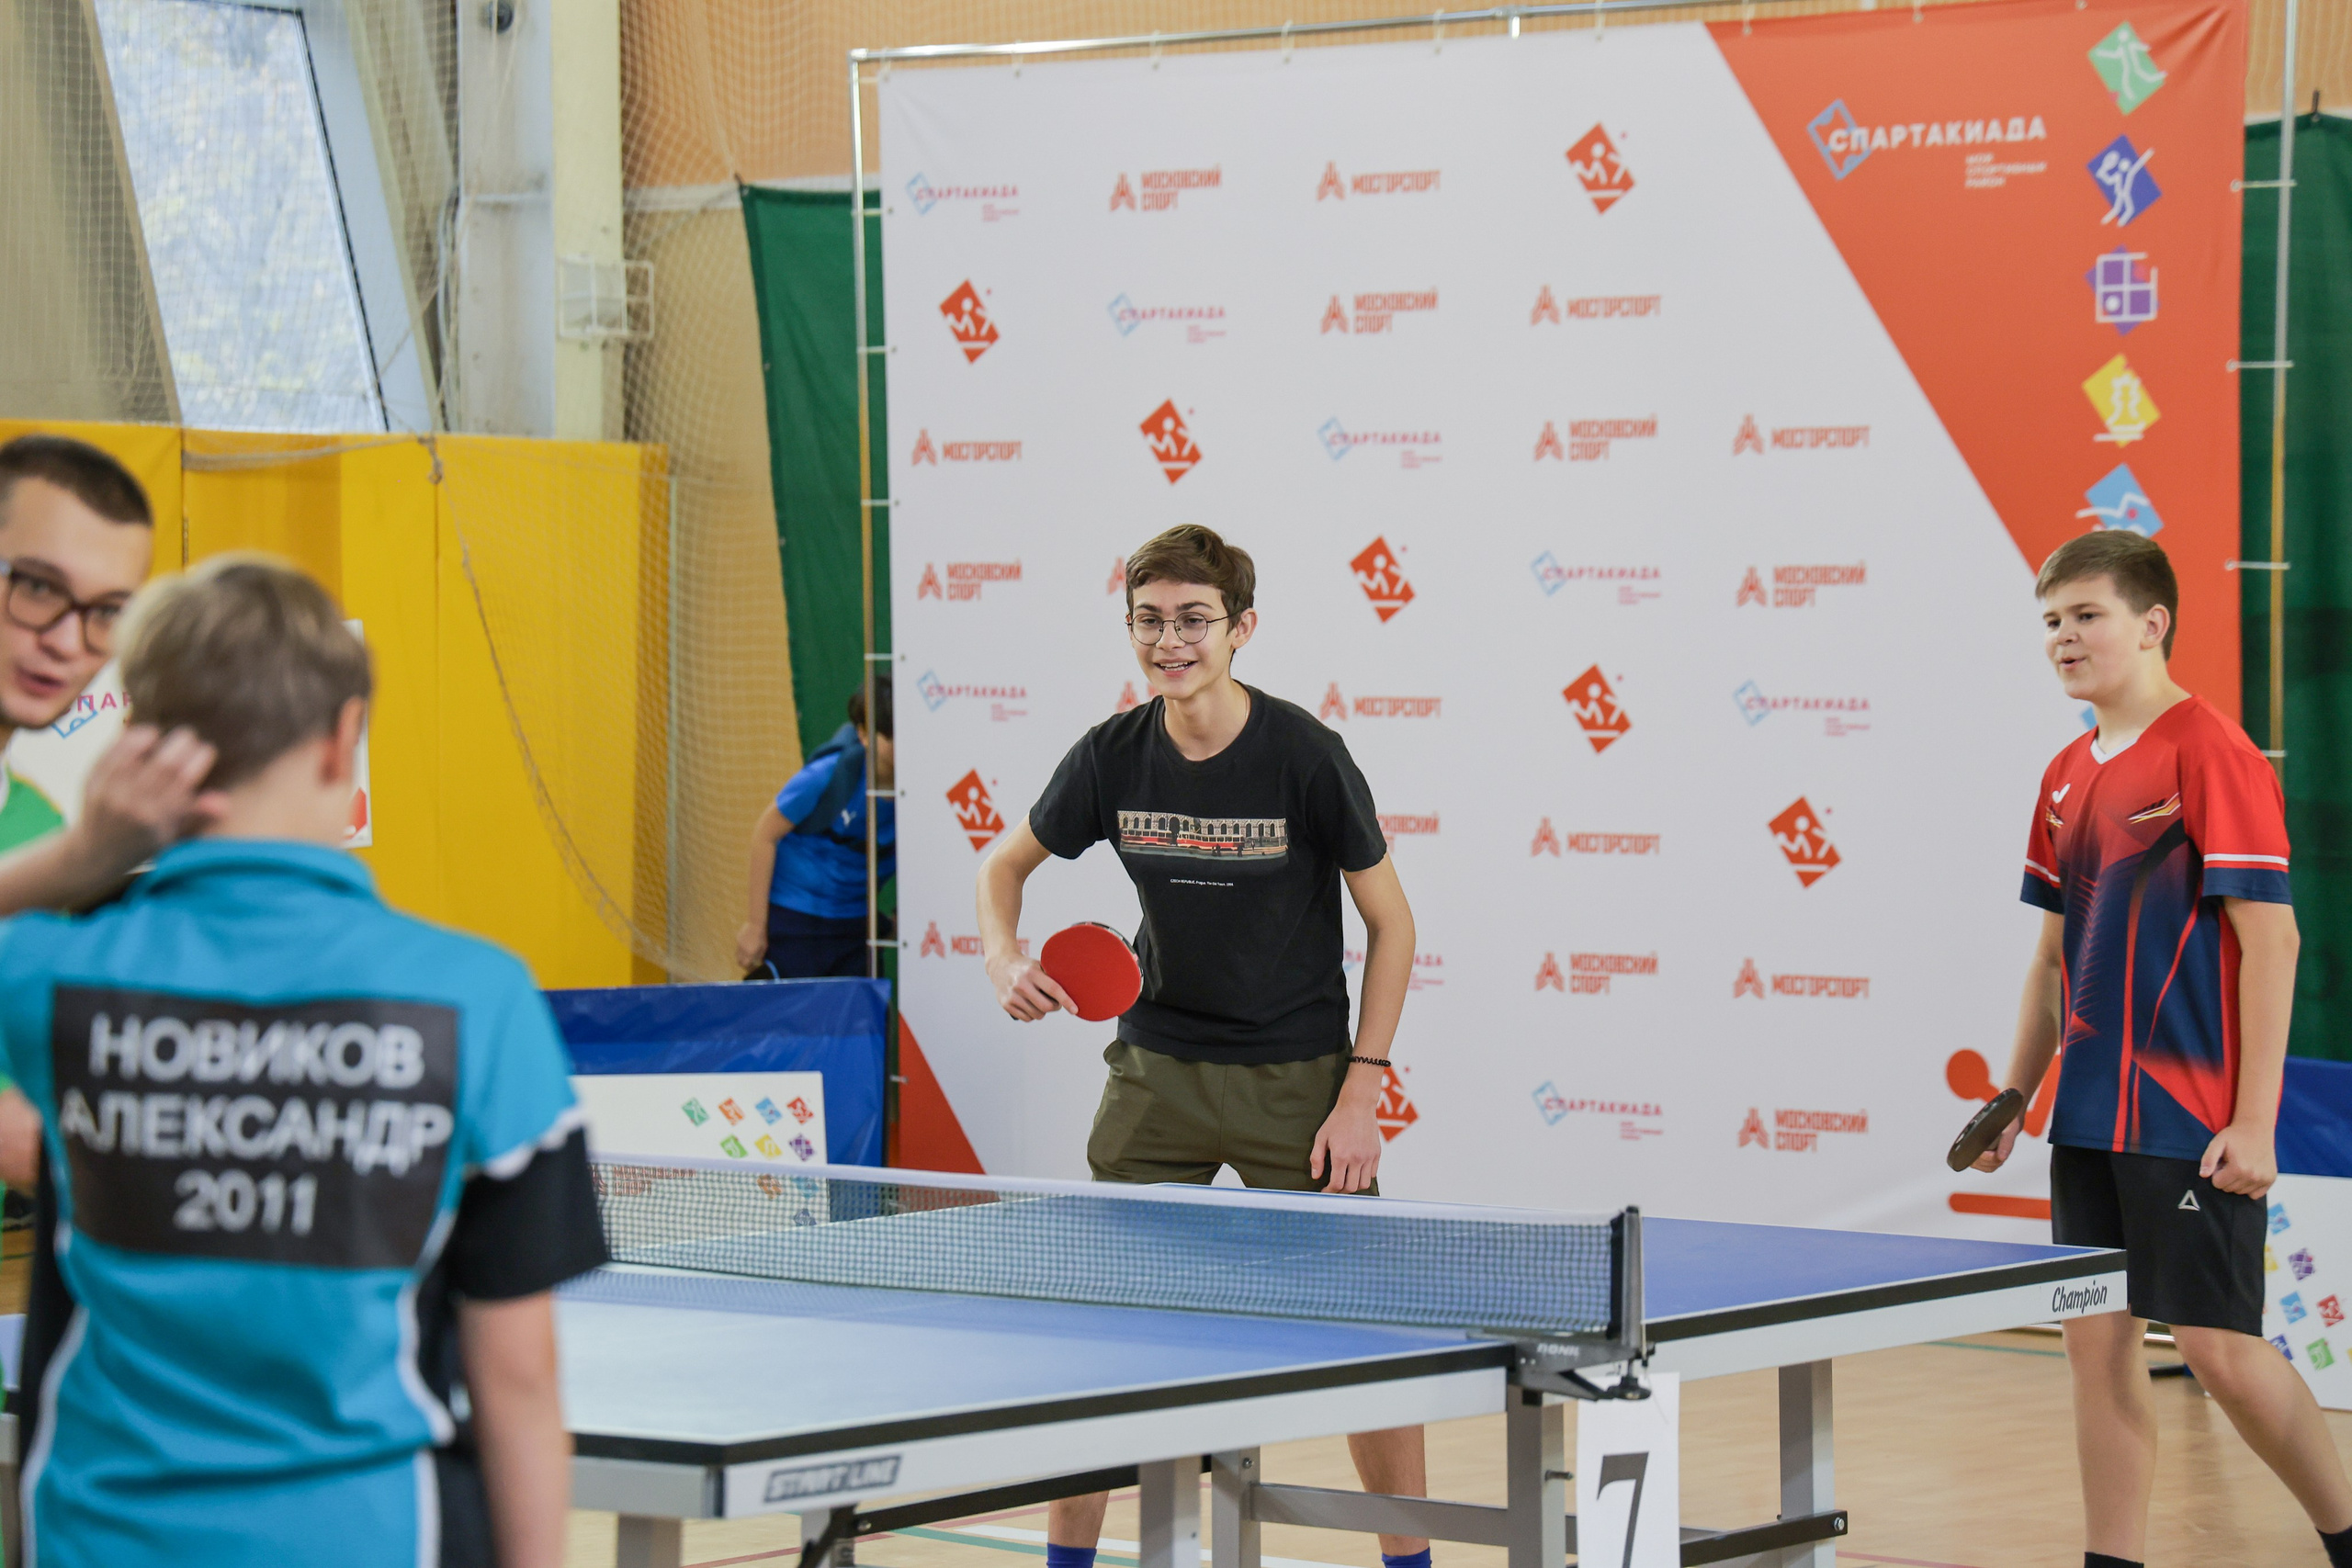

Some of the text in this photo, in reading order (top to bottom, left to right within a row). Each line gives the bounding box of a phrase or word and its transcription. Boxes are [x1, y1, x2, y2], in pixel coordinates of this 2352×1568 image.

[1828, 115, 2047, 152] СПАРТАКИАДА
[89, 1012, 424, 1089] НОВИКОВ
[60, 1088, 454, 1177] АЛЕКСАНДР
[1544, 1097, 1662, 1116] СПАРТАКИАДА
[174, 1170, 319, 1236] 2011
[2052, 1280, 2108, 1314] Champion
[1596, 1450, 1650, 1568] 7
